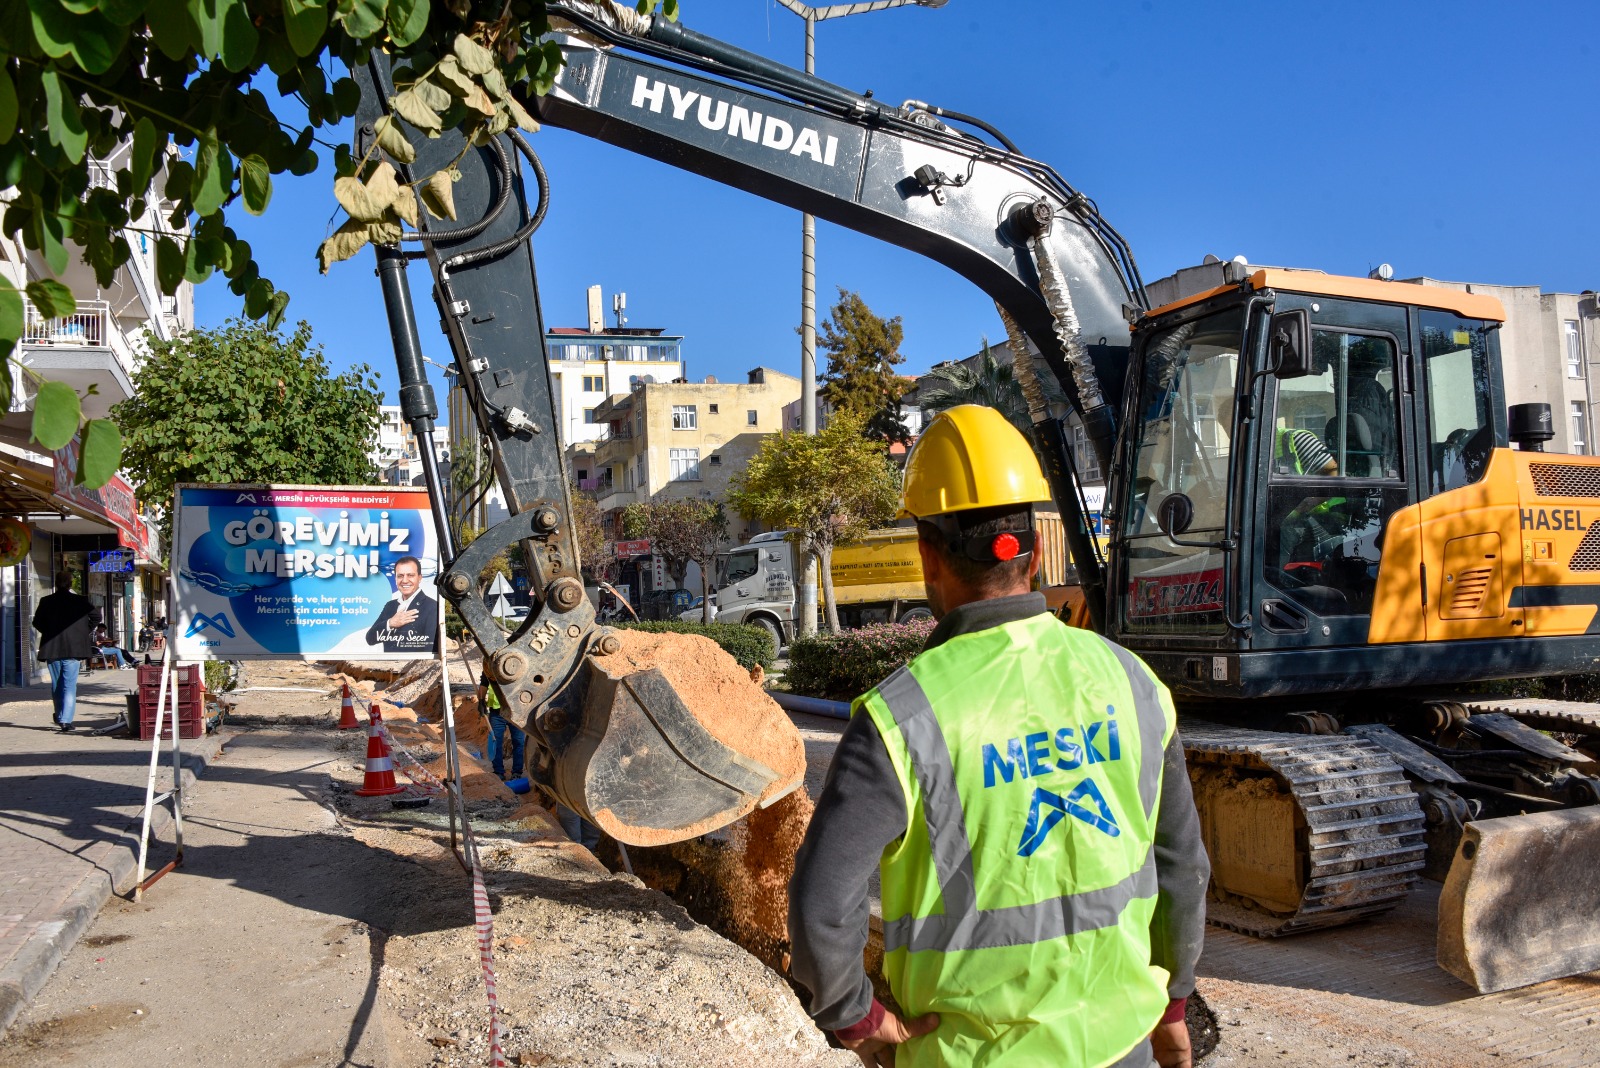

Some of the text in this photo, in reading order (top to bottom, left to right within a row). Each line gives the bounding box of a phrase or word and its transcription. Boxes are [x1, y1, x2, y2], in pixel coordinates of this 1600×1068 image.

[631, 74, 839, 167] HYUNDAI
[275, 494, 303, 502] MERSİN
[304, 495, 350, 504] BÜYÜKŞEHİR
[352, 495, 389, 504] BELEDİYESİ
[1519, 508, 1587, 531] HASEL
[223, 509, 410, 552] GÖREVİMİZ
[90, 561, 133, 572] TABELA
[244, 547, 379, 578] MERSİN!
[254, 594, 272, 604] Her
[274, 594, 303, 605] yerde
[321, 594, 338, 604] her
[340, 595, 372, 605] şartta,
[256, 605, 369, 616] Mersin için canla başla
[285, 616, 341, 627] çalışıyoruz.
[376, 628, 405, 647] Vahap
[982, 704, 1121, 789] MESKİ
